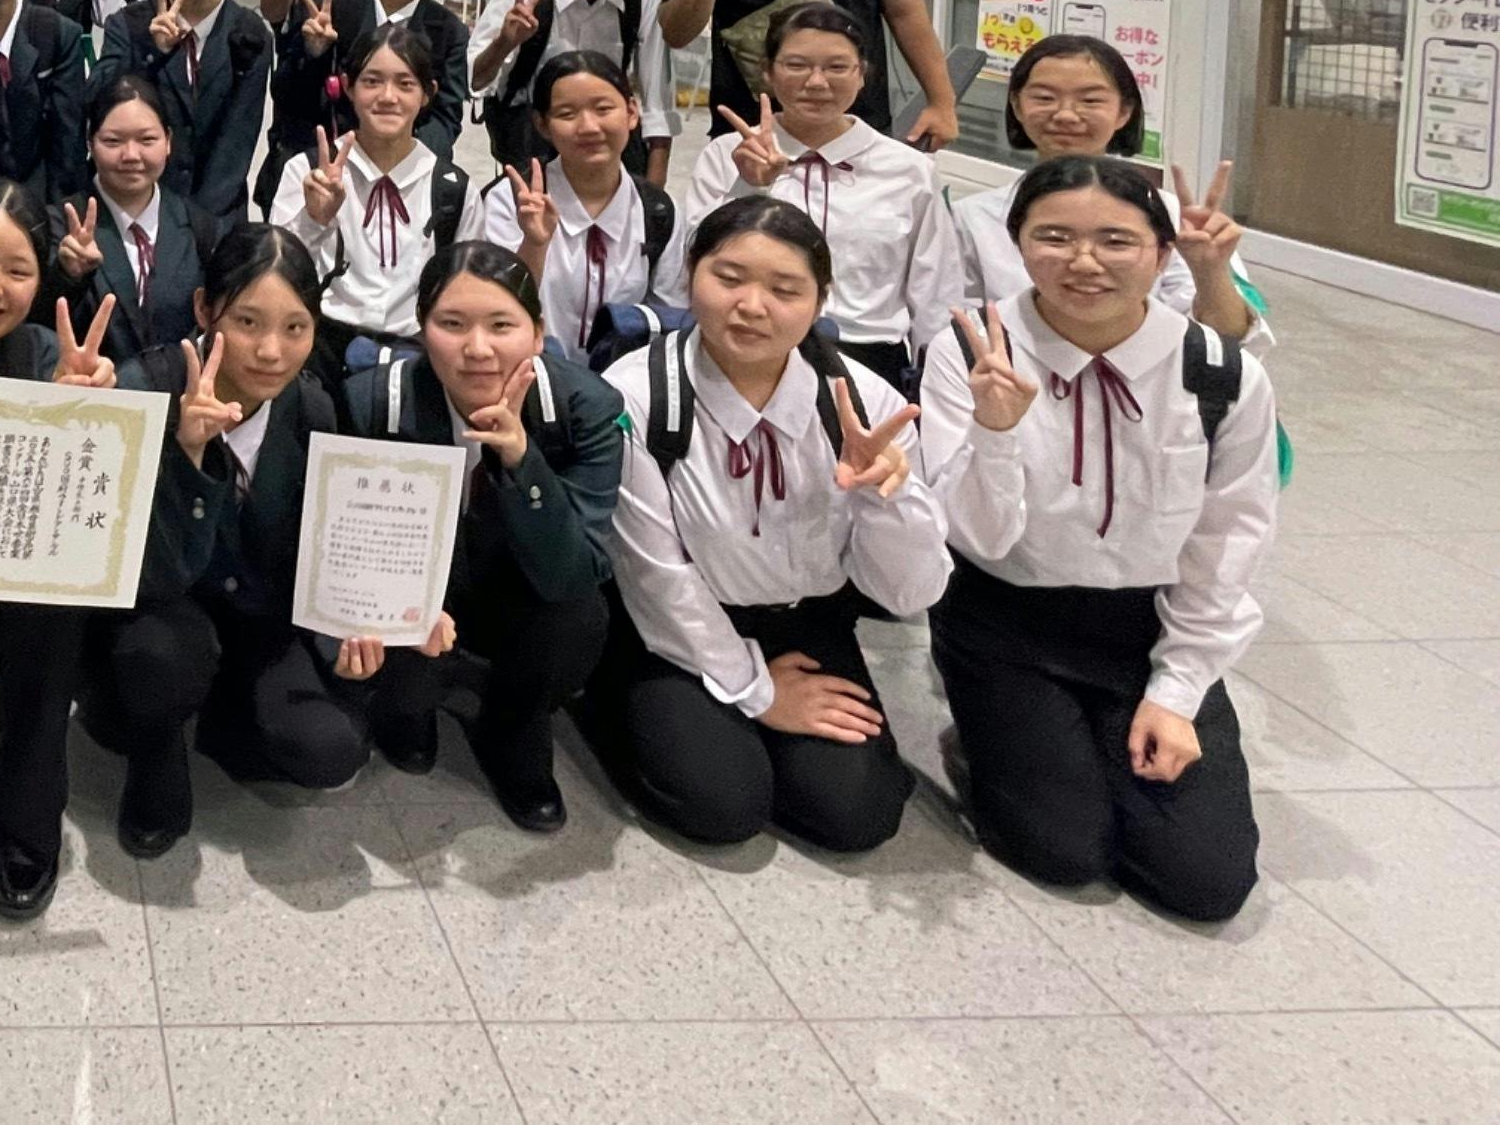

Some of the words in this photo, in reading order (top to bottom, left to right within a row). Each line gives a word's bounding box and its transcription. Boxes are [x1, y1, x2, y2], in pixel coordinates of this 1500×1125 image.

[1115, 26, 1159, 45] お得な
[1122, 51, 1164, 66] ーポン
[84, 471, 111, 529] 賞状
